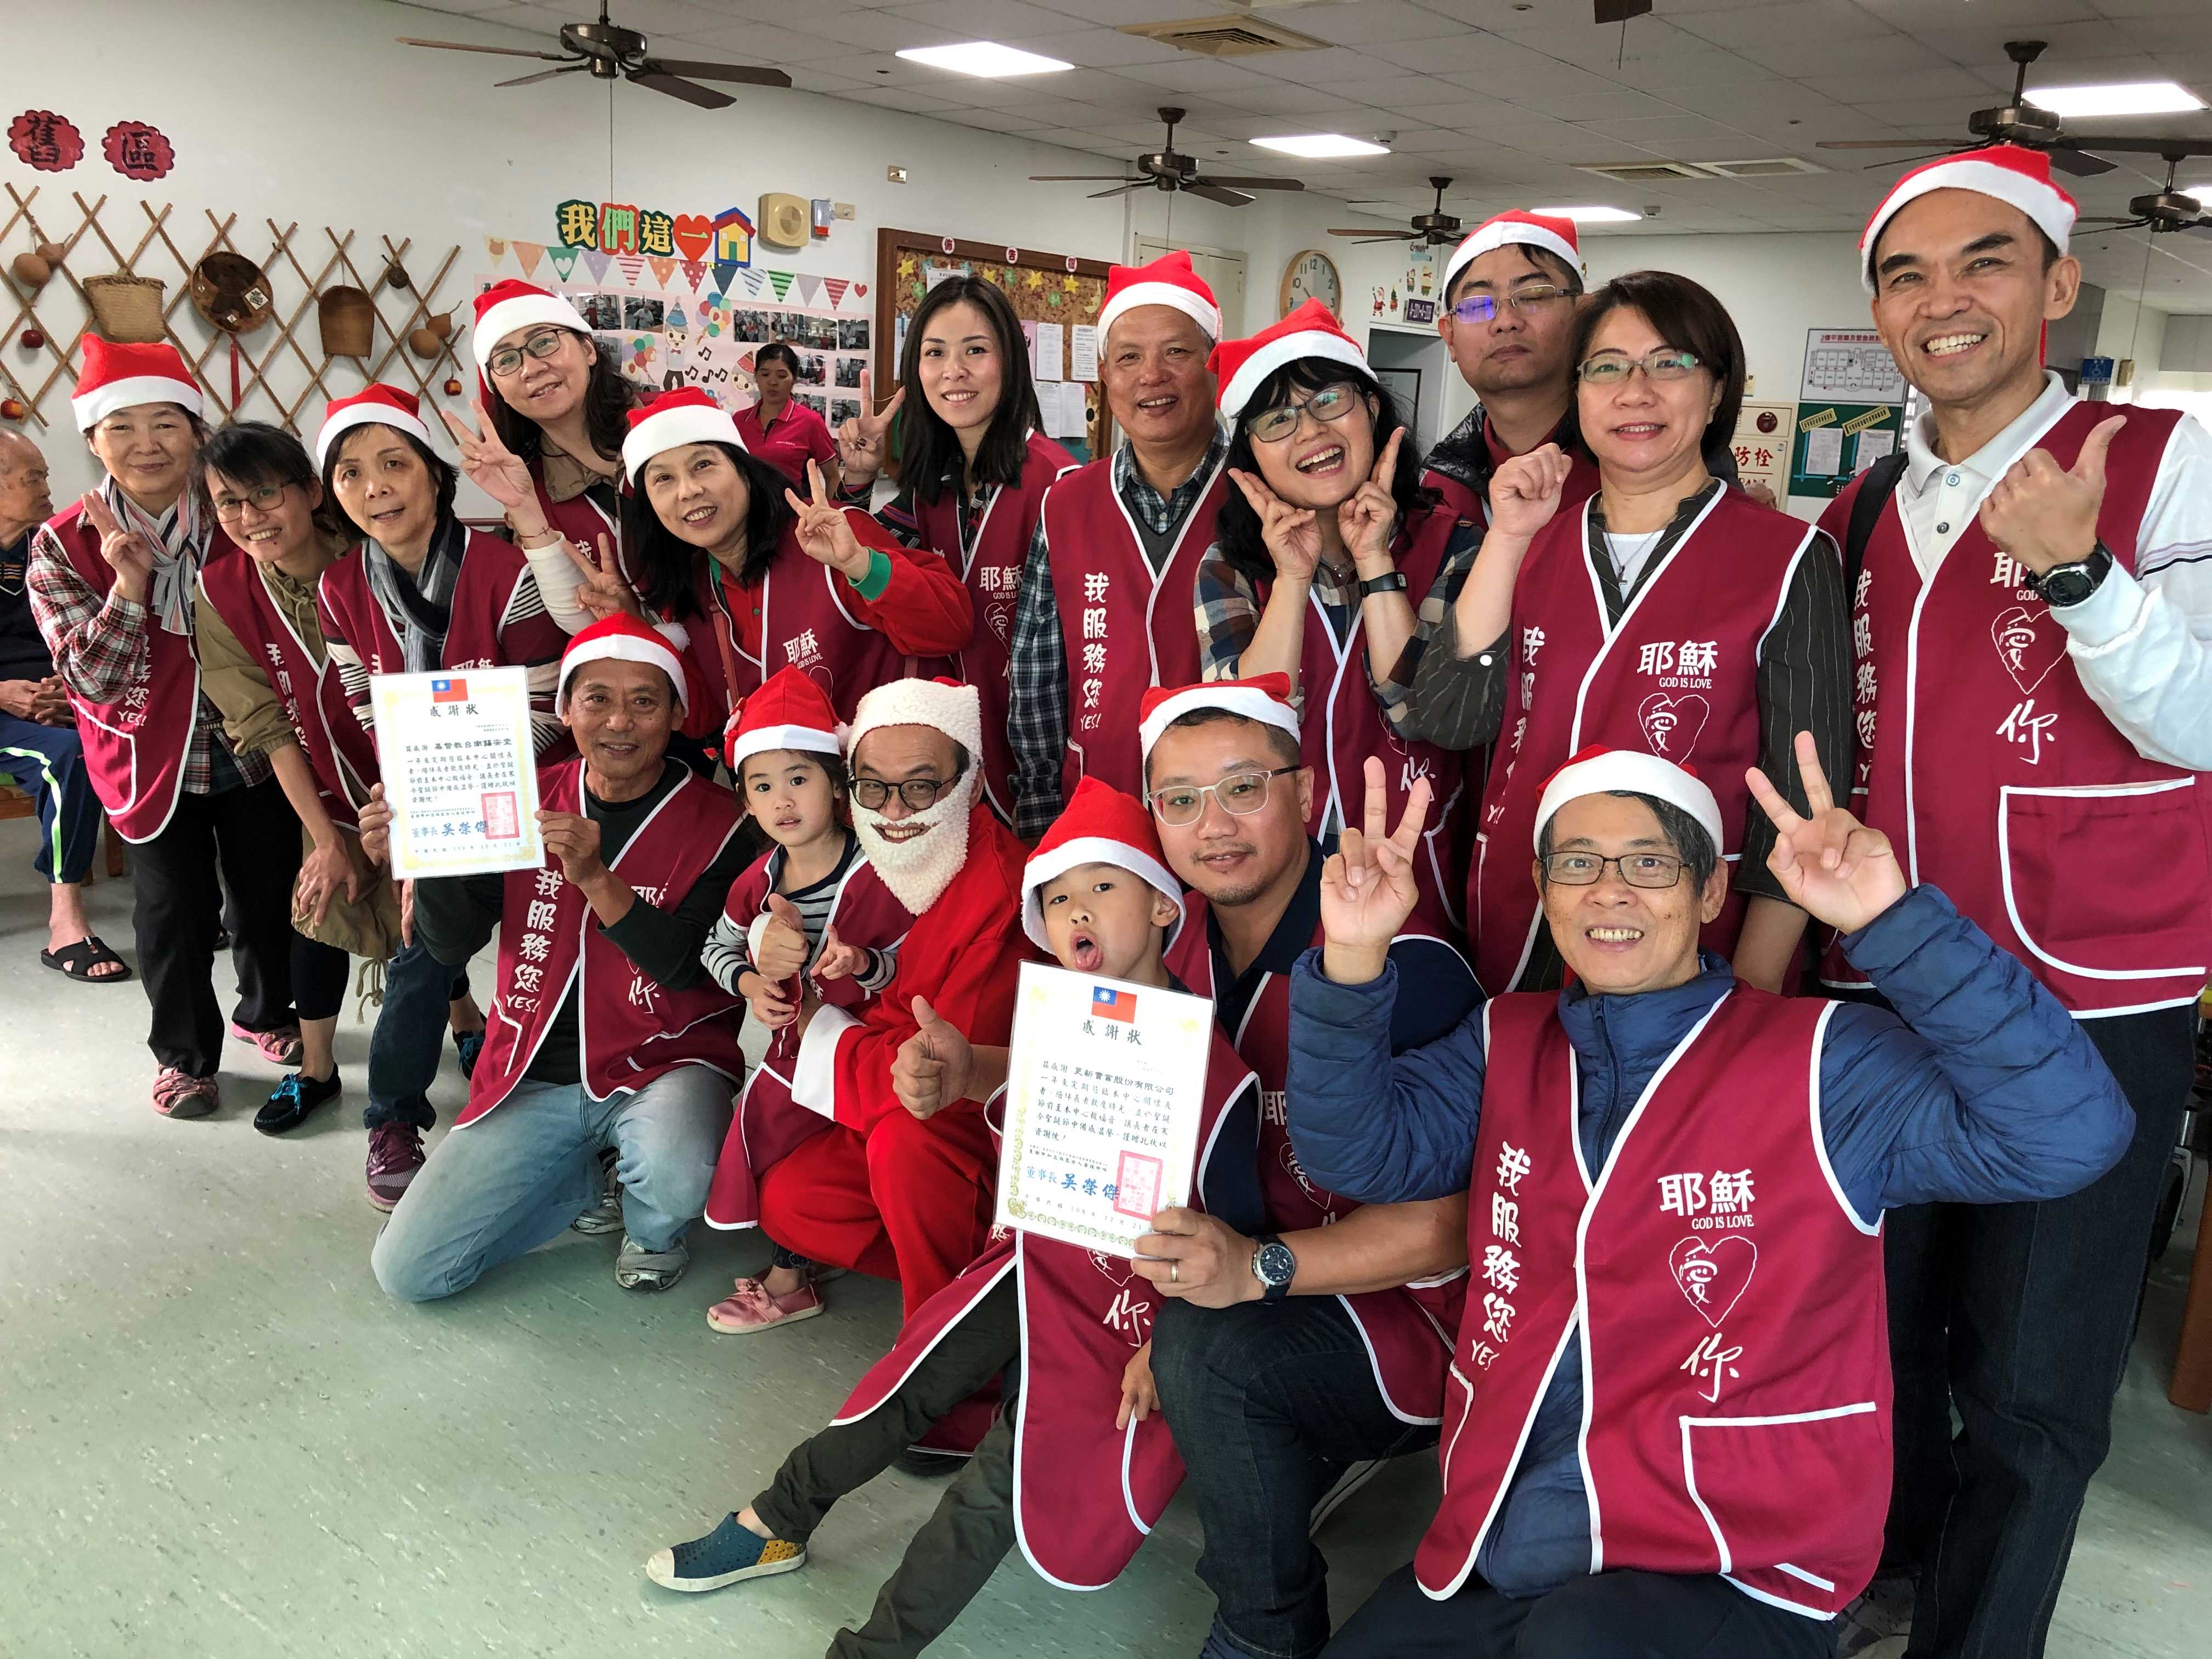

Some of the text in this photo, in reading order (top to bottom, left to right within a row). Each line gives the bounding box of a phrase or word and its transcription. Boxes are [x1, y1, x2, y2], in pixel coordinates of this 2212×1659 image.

[1300, 263, 1307, 274] 11
[1310, 258, 1318, 270] 12
[1322, 265, 1325, 275] 1
[1293, 278, 1301, 289] 10
[1328, 279, 1334, 289] 2
[1330, 297, 1335, 308] 3
[979, 565, 1023, 591] 耶穌
[993, 591, 1004, 600] GOD
[1006, 591, 1011, 600] IS
[783, 628, 819, 664] 耶穌
[1082, 572, 1110, 709] 我服務您
[1637, 640, 1718, 676] 耶穌
[1659, 677, 1712, 689] GOD IS LOVE
[117, 710, 148, 726] YES!
[430, 704, 478, 718] 感謝狀
[1080, 713, 1102, 732] YES!
[1996, 698, 2057, 765] 你
[514, 867, 563, 992] 我服務您
[506, 994, 542, 1014] YES!
[629, 975, 661, 1014] 你
[1082, 1019, 1142, 1046] 感謝狀
[1657, 1168, 1756, 1217] 耶穌
[1692, 1214, 1754, 1230] GOD IS LOVE
[1482, 1141, 1531, 1343] 我服務您
[1103, 1290, 1151, 1348] 你
[1680, 1333, 1743, 1403] 你
